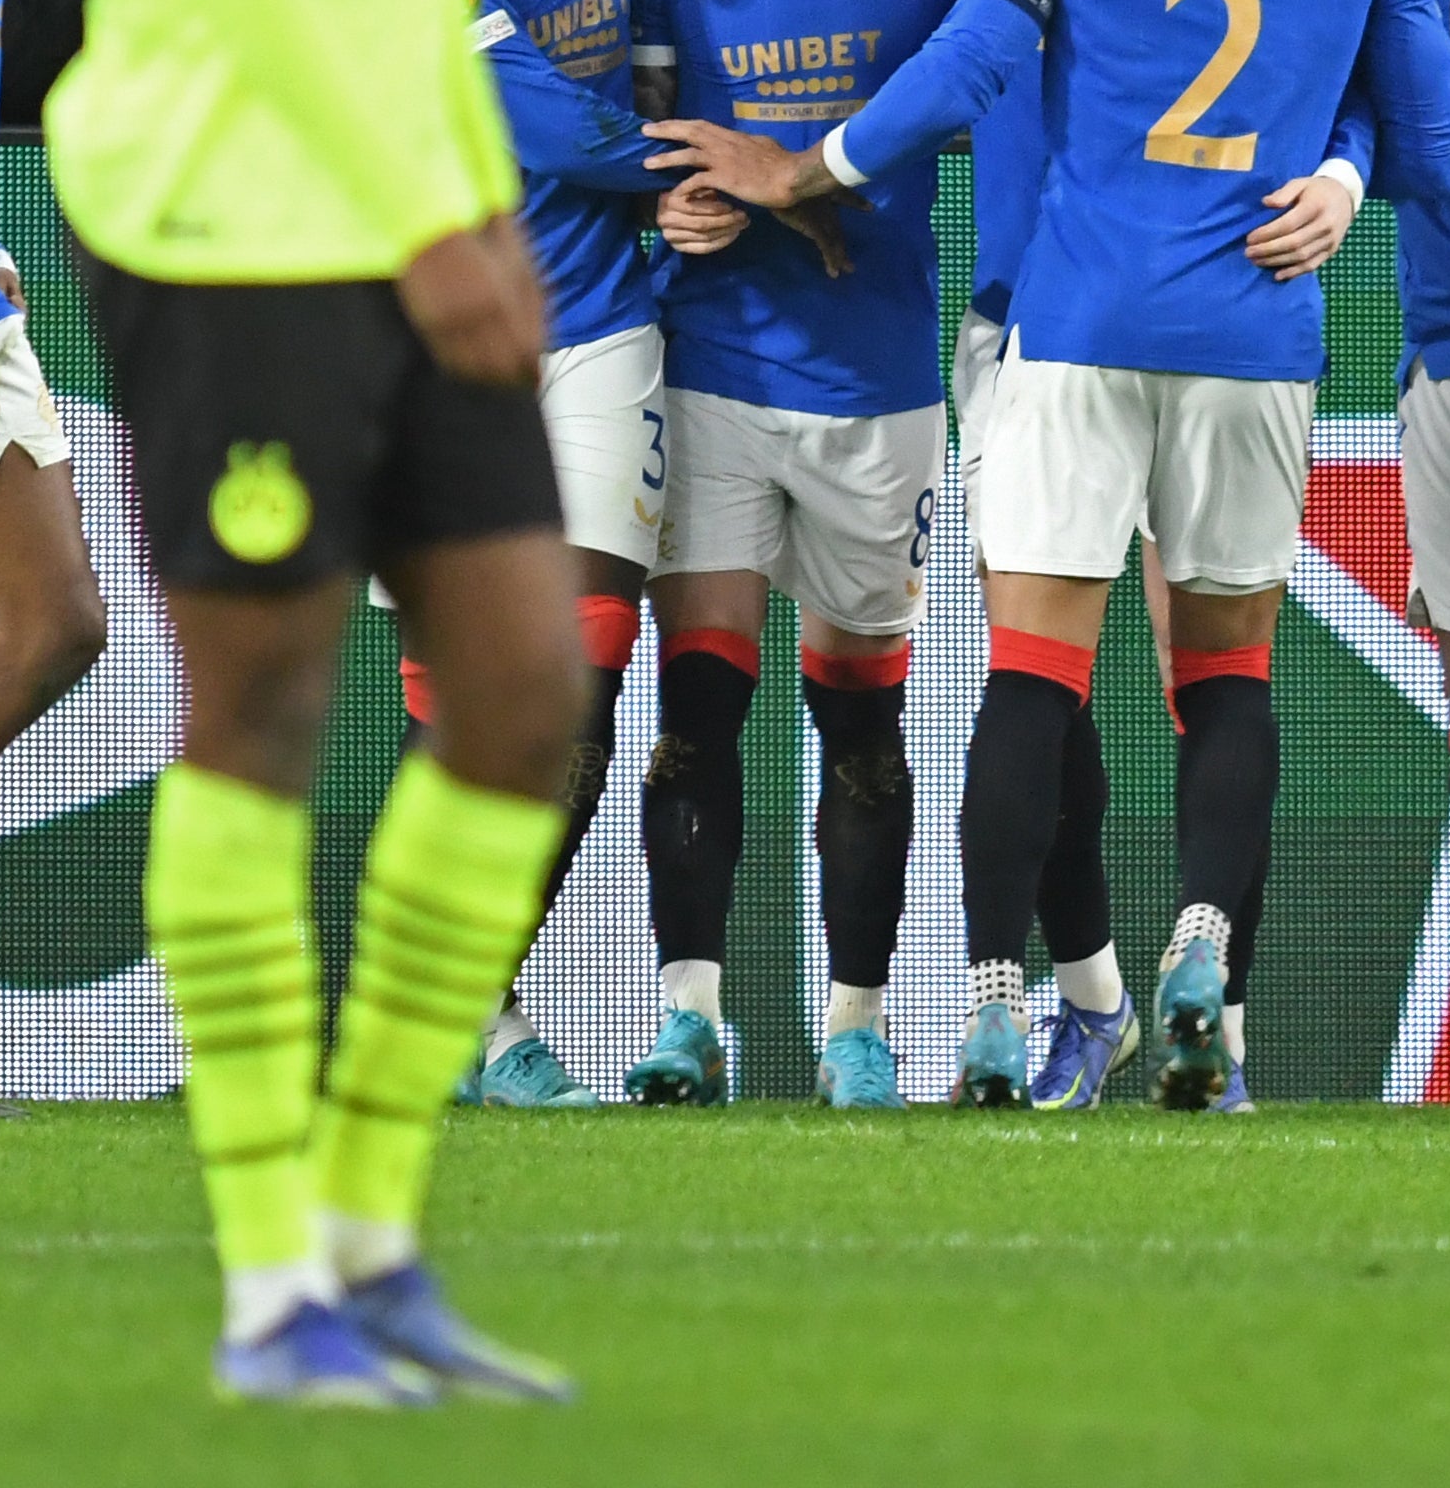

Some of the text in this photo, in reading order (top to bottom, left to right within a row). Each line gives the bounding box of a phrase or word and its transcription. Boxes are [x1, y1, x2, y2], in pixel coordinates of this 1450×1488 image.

[721, 29, 882, 78] UNIBET
[642, 408, 666, 491] 3
[909, 487, 934, 569] 8
